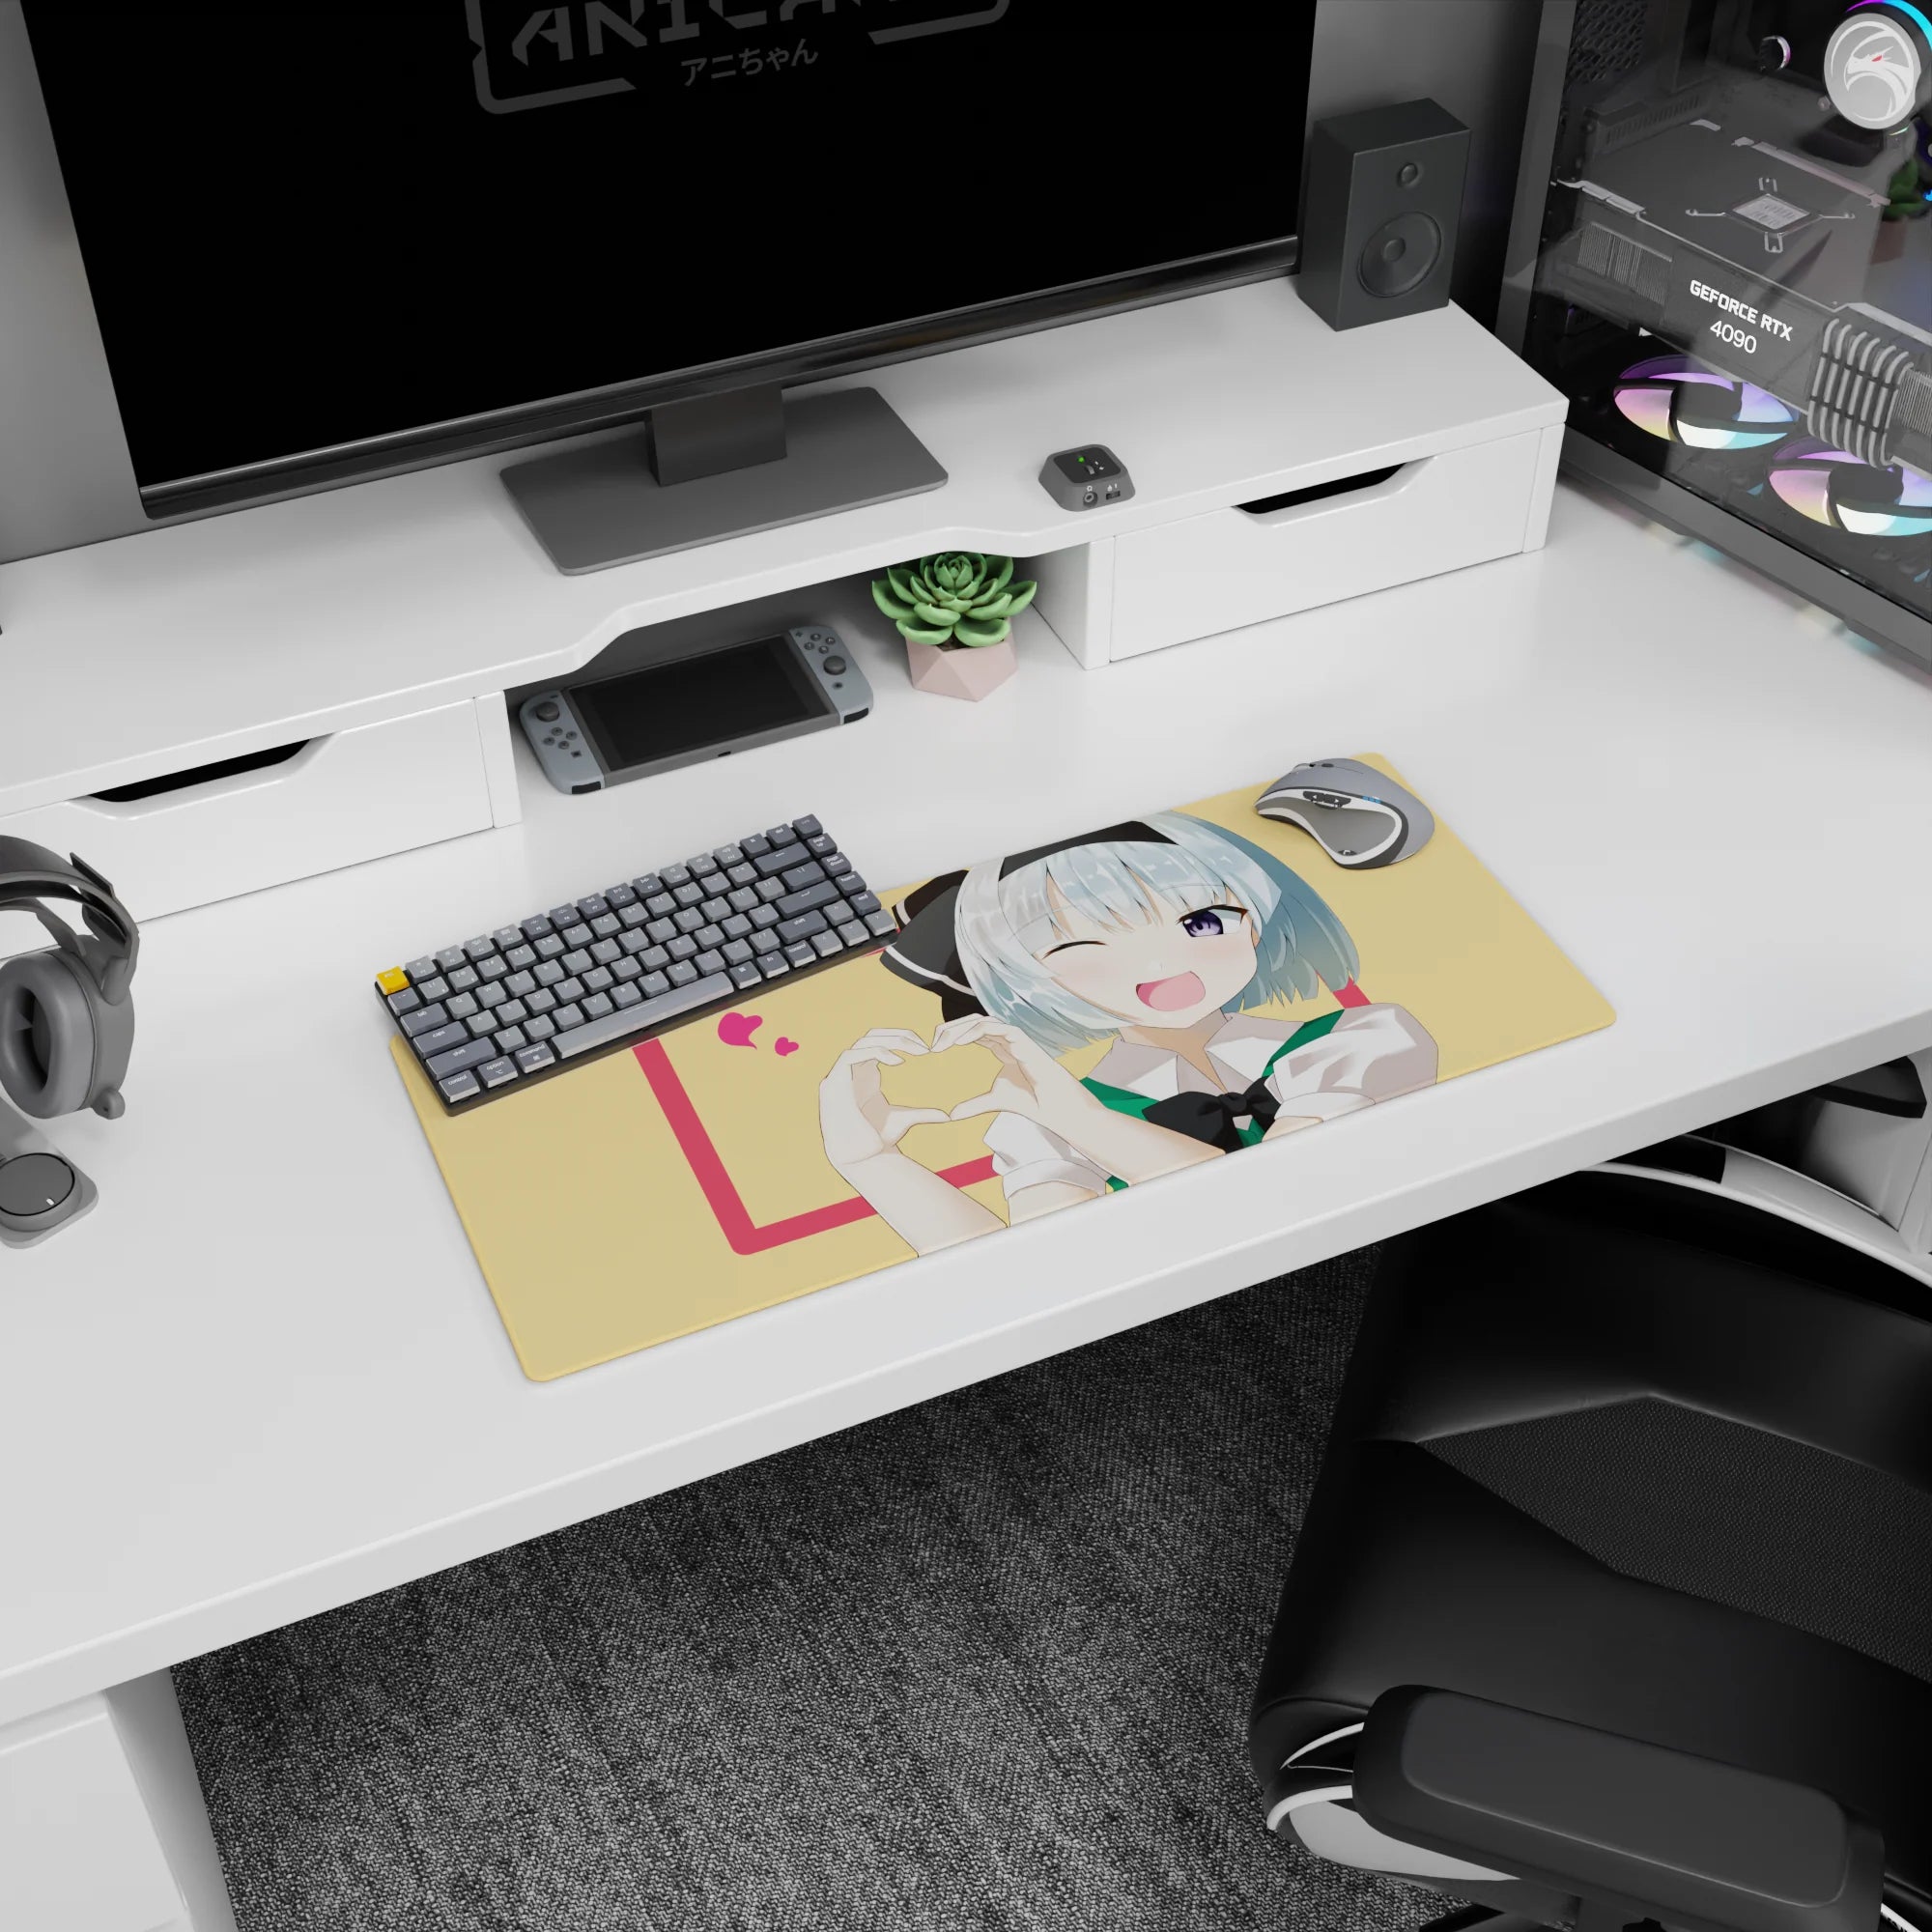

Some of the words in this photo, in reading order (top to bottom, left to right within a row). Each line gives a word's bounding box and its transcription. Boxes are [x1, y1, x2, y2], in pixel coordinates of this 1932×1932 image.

[681, 39, 819, 87] アニちゃん
[1690, 279, 1758, 325] GEFORCE
[1760, 313, 1793, 341] RTX
[1710, 320, 1757, 354] 4090
[519, 1044, 546, 1058] command
[486, 1061, 504, 1071] option
[447, 1074, 468, 1086] control
